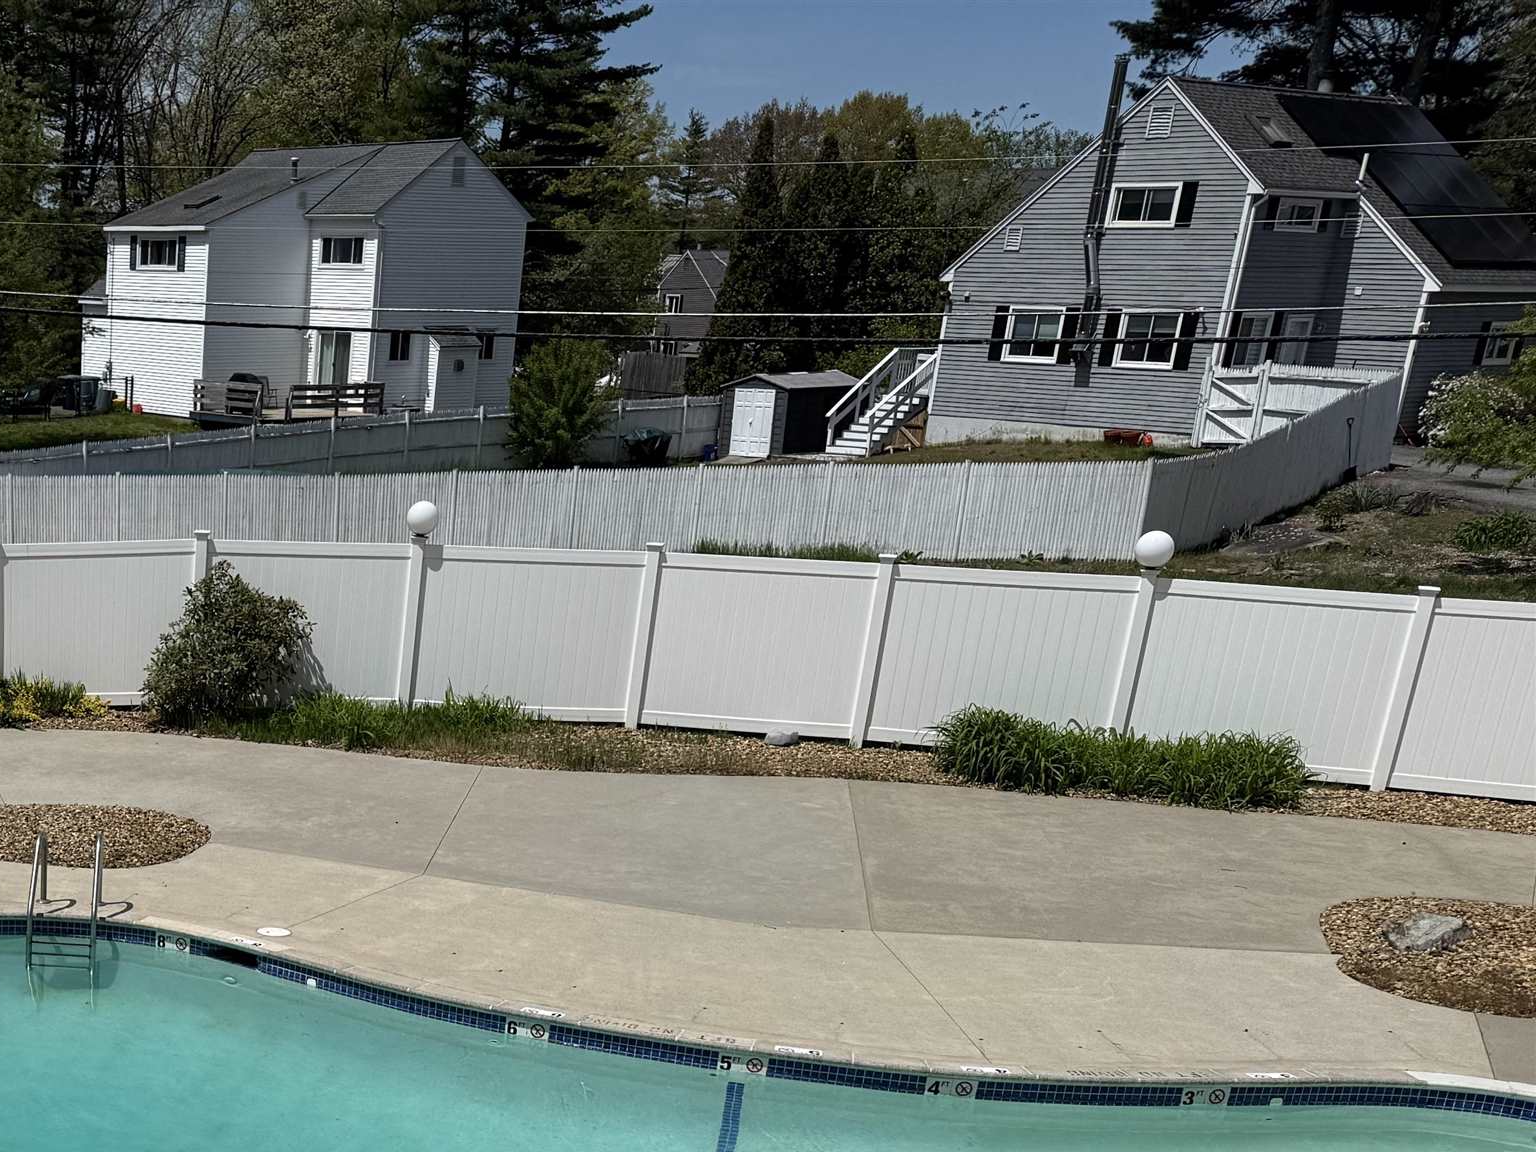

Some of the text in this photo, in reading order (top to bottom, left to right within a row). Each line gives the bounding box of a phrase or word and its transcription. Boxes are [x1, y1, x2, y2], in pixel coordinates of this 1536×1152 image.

[158, 935, 166, 948] 8
[507, 1020, 518, 1035] 6
[719, 1055, 732, 1071] 5
[927, 1080, 941, 1095] 4
[1182, 1090, 1195, 1106] 3
